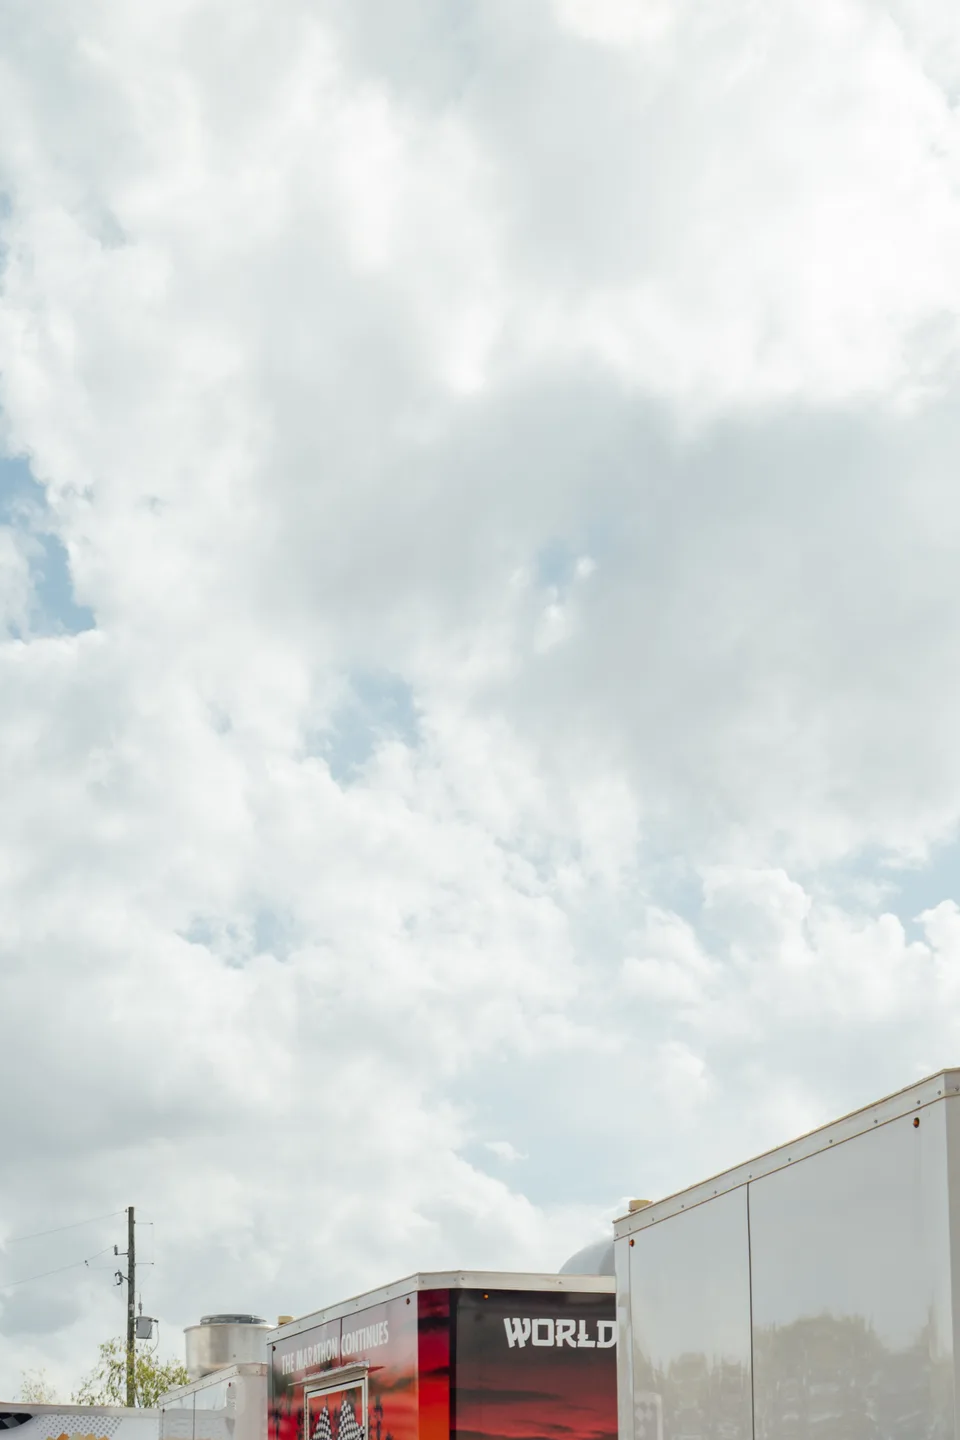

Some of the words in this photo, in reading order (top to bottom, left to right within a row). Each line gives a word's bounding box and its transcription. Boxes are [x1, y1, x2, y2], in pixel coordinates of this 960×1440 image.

[281, 1350, 295, 1375] THE
[296, 1337, 338, 1371] MARATHON
[341, 1320, 389, 1357] CONTINUES
[503, 1317, 617, 1349] WORLD
